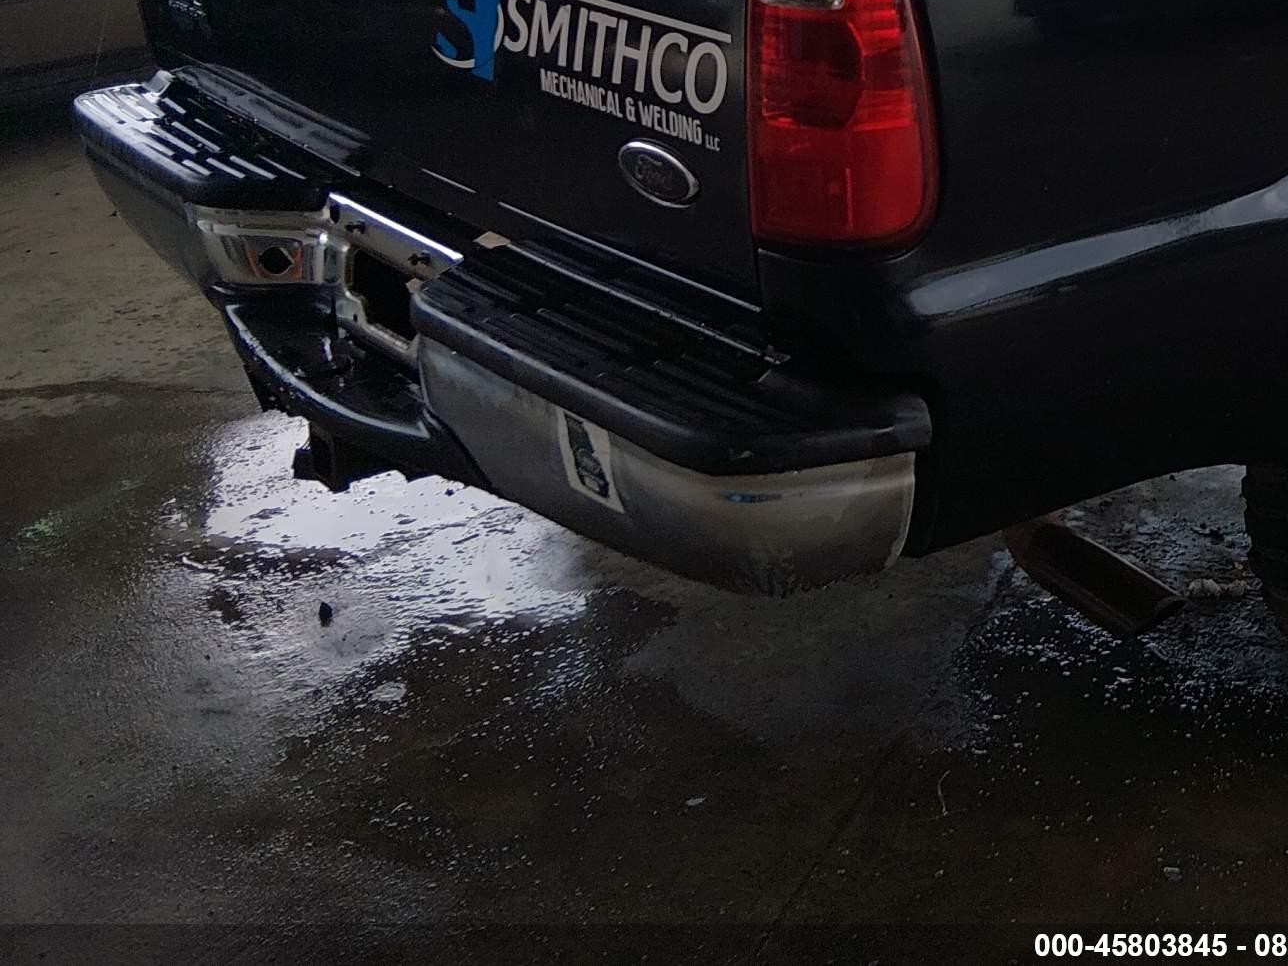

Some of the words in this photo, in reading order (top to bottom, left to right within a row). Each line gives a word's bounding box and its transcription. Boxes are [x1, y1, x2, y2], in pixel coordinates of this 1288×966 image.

[540, 67, 623, 119] MECHANICAL
[625, 96, 636, 121] &
[637, 99, 703, 144] WELDING
[705, 133, 721, 151] LLC
